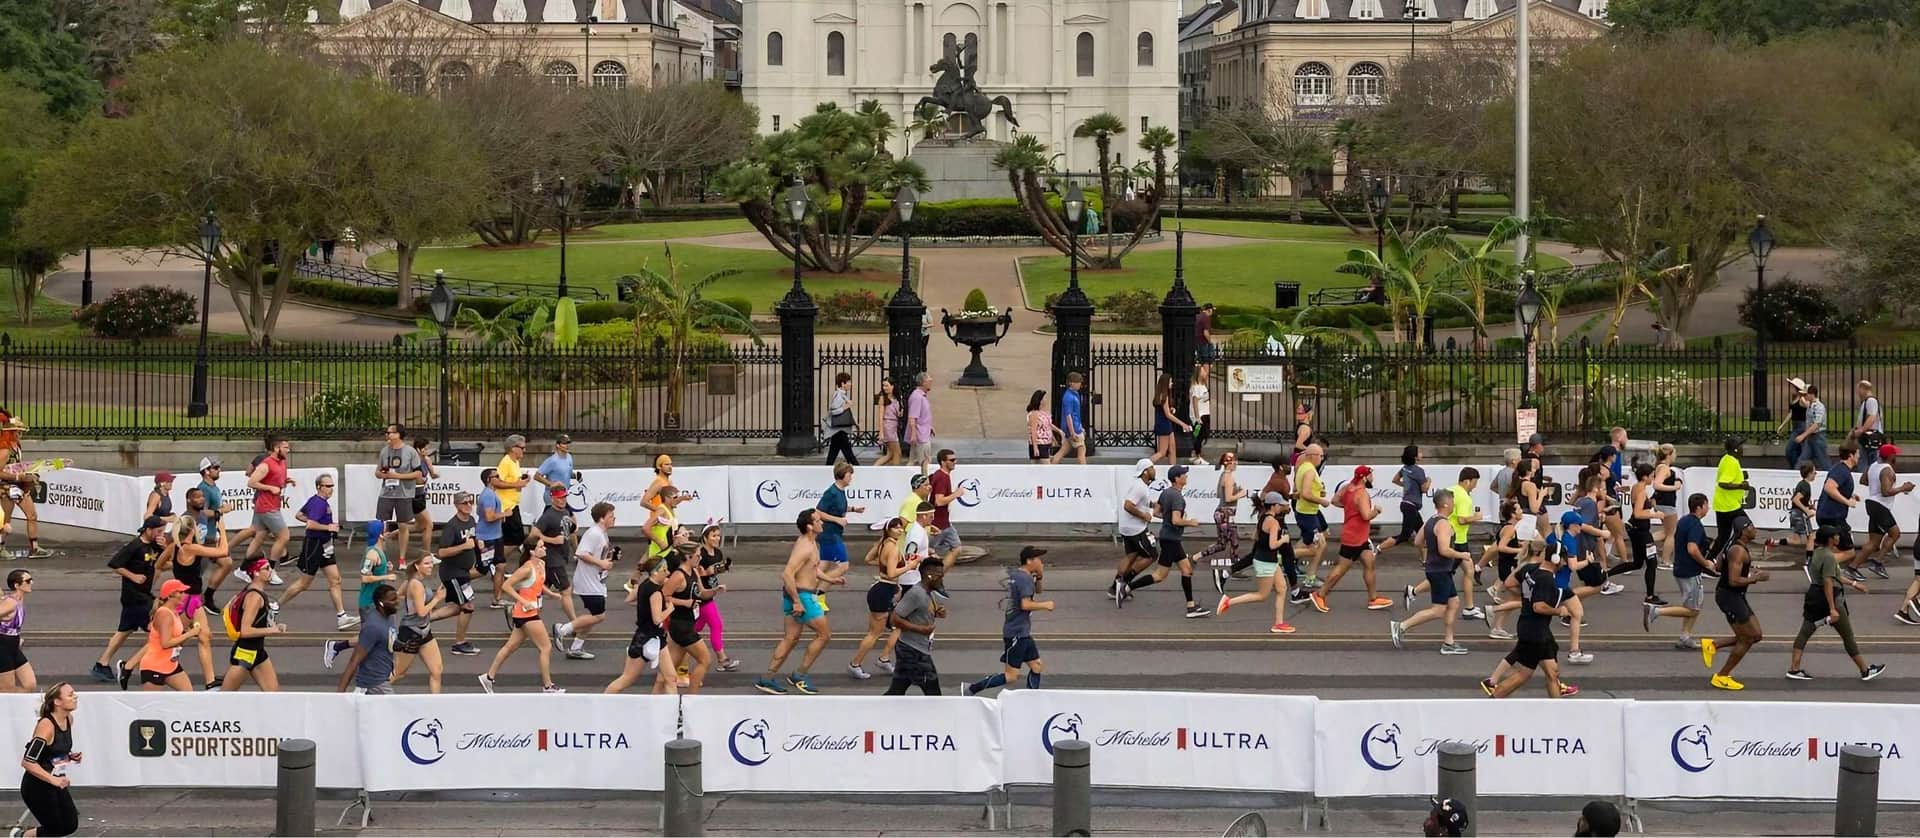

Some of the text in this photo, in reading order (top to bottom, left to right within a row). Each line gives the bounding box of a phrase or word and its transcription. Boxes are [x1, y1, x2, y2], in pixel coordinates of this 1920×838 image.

[49, 482, 82, 494] CAESARS
[425, 483, 461, 491] AESARS
[846, 489, 893, 500] ULTRA
[1046, 488, 1093, 499] ULTRA
[48, 492, 105, 512] SPORTSBOOK
[170, 720, 242, 734] CAESARS
[170, 736, 279, 757] SPORTSBOO
[455, 731, 629, 751] Michelob ULTRA
[782, 733, 957, 752] Michelob ULTRA
[1095, 728, 1269, 750] Michelob ULTRA
[1511, 737, 1587, 754] ULTRA
[1725, 740, 1804, 758] Michelob
